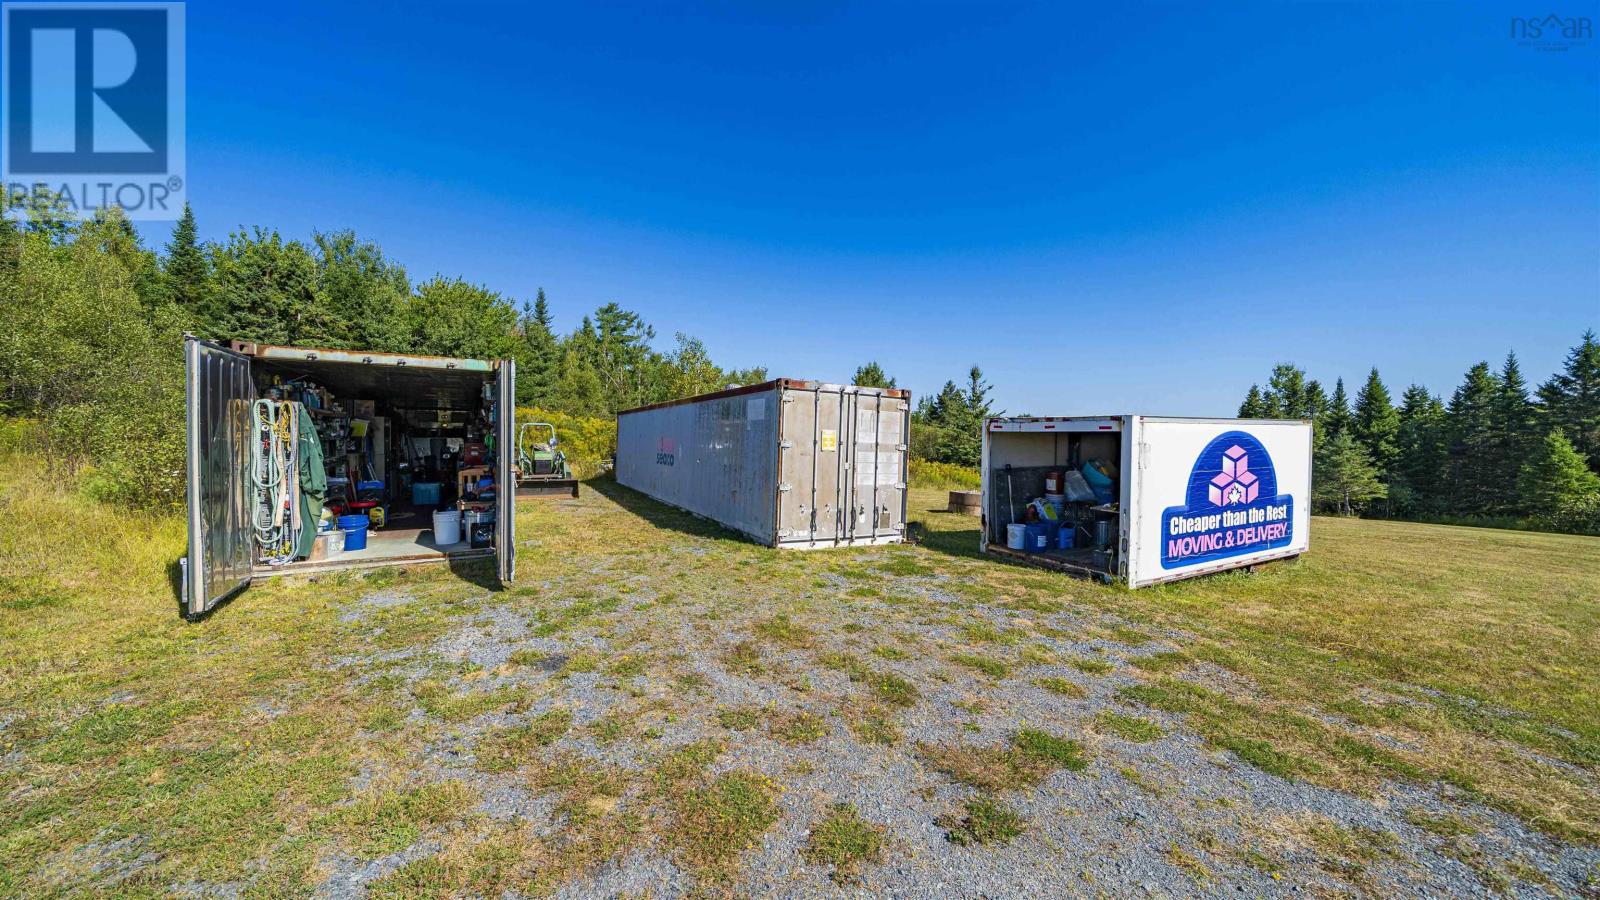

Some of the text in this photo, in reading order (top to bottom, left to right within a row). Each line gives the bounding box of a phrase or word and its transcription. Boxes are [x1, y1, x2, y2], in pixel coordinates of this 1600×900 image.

[1170, 505, 1287, 535] Cheaper than the Rest
[1168, 522, 1287, 557] MOVING & DELIVERY
